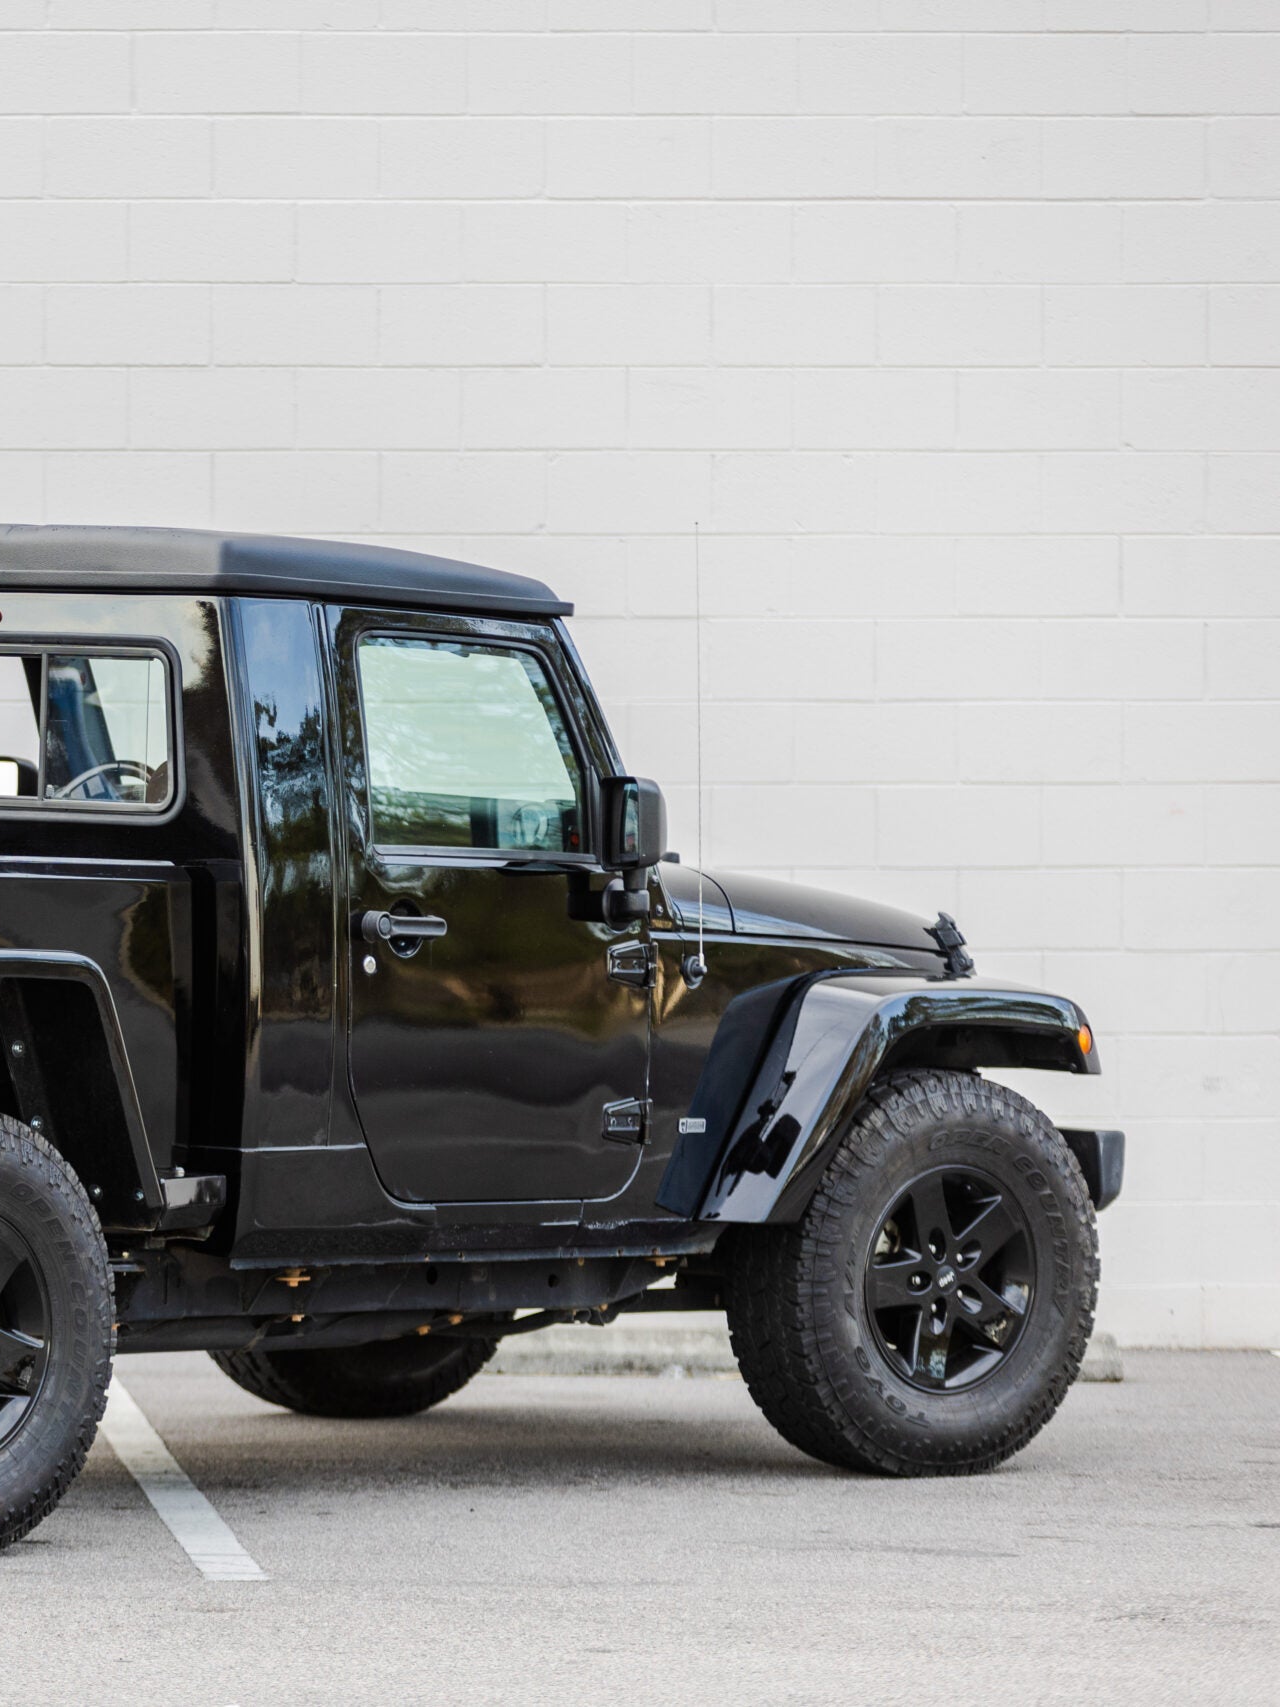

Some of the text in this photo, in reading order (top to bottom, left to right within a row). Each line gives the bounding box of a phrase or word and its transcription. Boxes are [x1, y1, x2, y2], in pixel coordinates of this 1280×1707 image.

[10, 1183, 77, 1265] OPEN
[929, 1128, 1071, 1318] OPEN COUNTRY
[855, 1345, 930, 1429] TOYO
